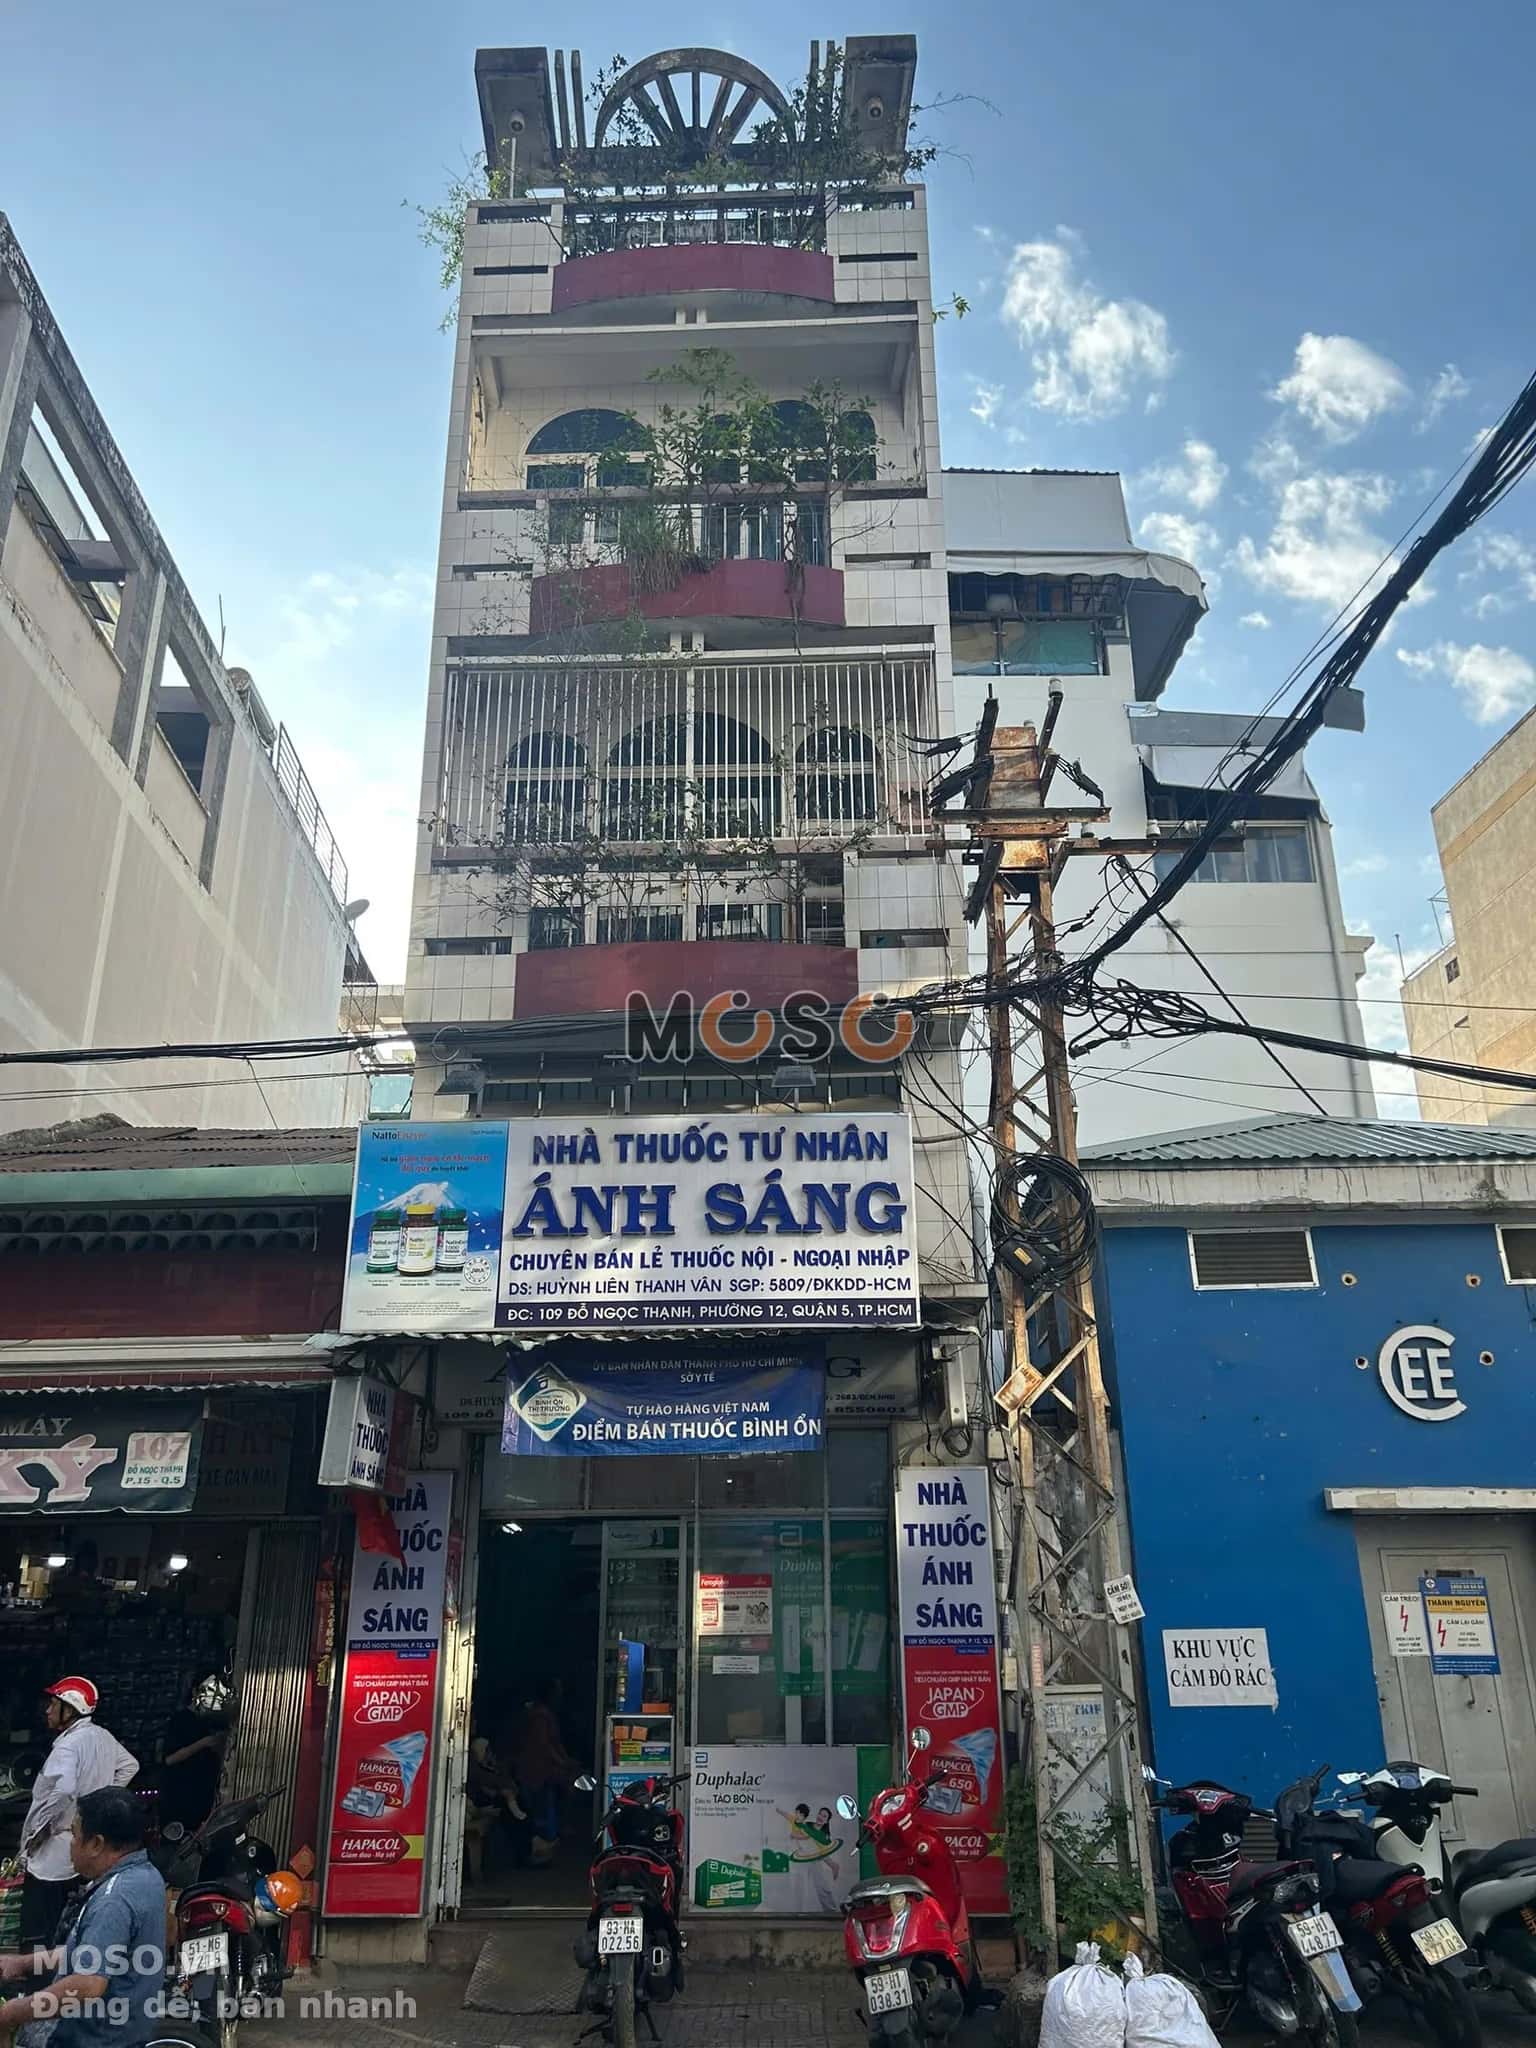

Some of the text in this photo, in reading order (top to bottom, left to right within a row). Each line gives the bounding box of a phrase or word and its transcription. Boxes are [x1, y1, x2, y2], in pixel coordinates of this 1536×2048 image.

[533, 1122, 888, 1164] NHÀ THUỐC TƯ NHÂN
[512, 1169, 907, 1238] ÁNH SÁNG
[509, 1250, 587, 1271] CHUYÊN
[594, 1248, 633, 1269] BÁN
[640, 1245, 663, 1269] LẺ
[670, 1244, 735, 1268] THUỐC
[741, 1246, 774, 1270] NỘI
[793, 1250, 850, 1270] NGOẠI
[857, 1245, 910, 1269] NHẬP
[508, 1282, 532, 1295] DS:
[536, 1277, 591, 1295] HUỲNH
[595, 1277, 629, 1294] LIÊN
[635, 1280, 686, 1293] THANH
[691, 1276, 722, 1292] VÂN
[729, 1278, 765, 1292] SGP:
[507, 1308, 533, 1321] ĐC:
[539, 1308, 563, 1320] 109
[593, 1306, 639, 1321] NGỌC
[643, 1306, 695, 1320] THẠNH,
[700, 1303, 763, 1318] PHƯỜNG
[769, 1305, 788, 1318] 12,
[792, 1303, 837, 1318] QUẬN
[841, 1305, 854, 1318] 5,
[858, 1304, 912, 1316] TP.HCM
[695, 1374, 702, 1382] Y
[627, 1401, 770, 1418] TỰ HÀO HÀNG VIỆT NAM
[573, 1414, 822, 1440] ĐIỂM BÁN THUỐC BÌNH ỔN
[131, 1437, 189, 1460] 107
[357, 1422, 389, 1457] THUỐC
[351, 1456, 367, 1480] ÁNH
[917, 1476, 968, 1506] NHÀ
[903, 1514, 987, 1547] THUỐC
[373, 1560, 425, 1590] ÁNH
[922, 1555, 973, 1586] ÁNH
[362, 1602, 429, 1632] SÁNG
[916, 1597, 983, 1628] SÁNG
[1173, 1636, 1256, 1662] KHU VỰC
[1171, 1664, 1205, 1687] CẤM
[1235, 1663, 1267, 1686] RÁC
[362, 1691, 411, 1708] JAPAN
[926, 1687, 975, 1704] JAPAN
[370, 1708, 401, 1720] GMP
[935, 1704, 966, 1716] GMP
[359, 1762, 399, 1776] HAPACOL
[931, 1760, 973, 1772] HAPACOL
[374, 1781, 397, 1794] 650
[949, 1778, 972, 1790] 650
[342, 1838, 400, 1850] HAPACOL
[945, 1836, 984, 1848] PACOL
[1296, 1917, 1328, 1937] 59-H1
[602, 1936, 639, 1951] 022.56
[871, 1973, 901, 1994] 59-H1
[871, 1989, 908, 2012] 038.31
